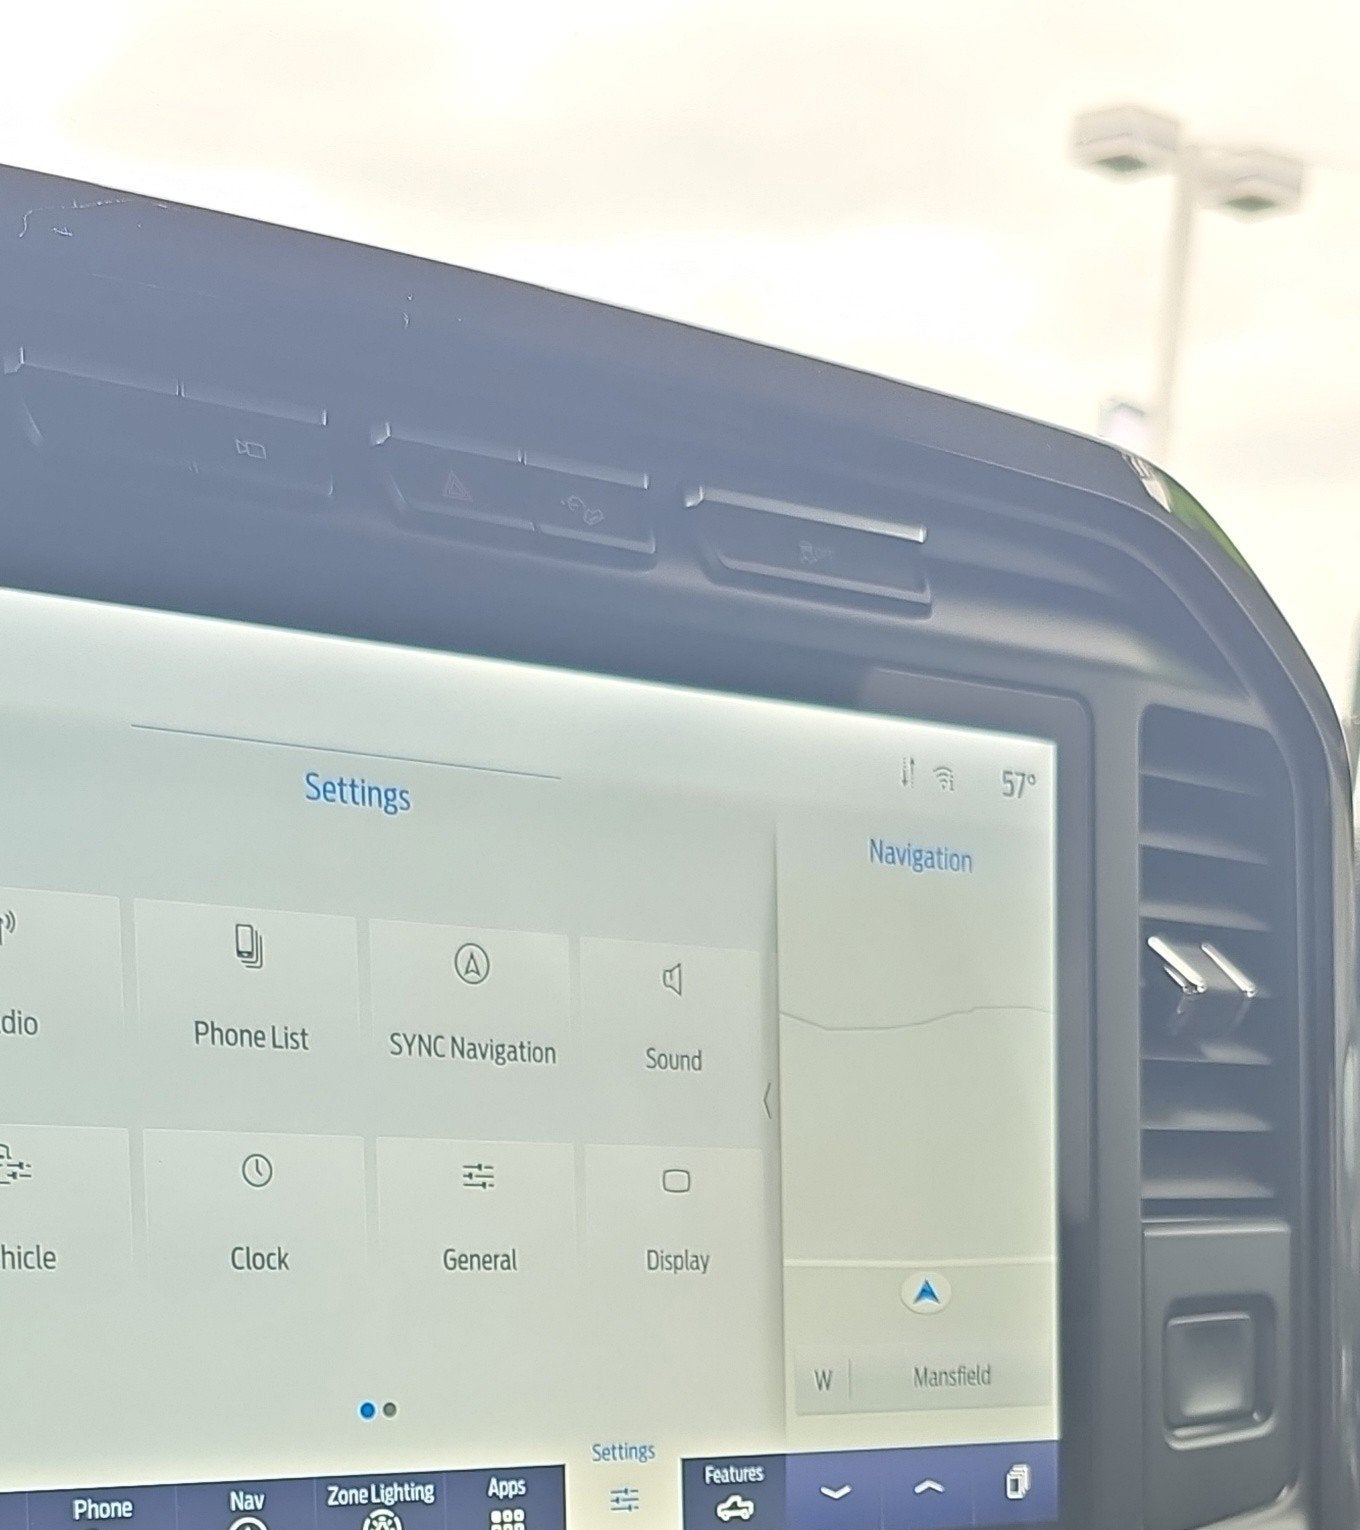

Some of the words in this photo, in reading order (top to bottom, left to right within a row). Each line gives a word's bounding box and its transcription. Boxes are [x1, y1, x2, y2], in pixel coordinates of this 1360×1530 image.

[304, 771, 413, 815] Settings
[869, 837, 974, 874] Navigation
[194, 1019, 266, 1049] Phone
[271, 1023, 310, 1051] List
[389, 1032, 446, 1059] SYNC
[450, 1035, 557, 1067] Navigation
[645, 1047, 703, 1072] Sound
[230, 1245, 290, 1272] Clock
[442, 1247, 518, 1272] General
[645, 1248, 710, 1275] Display
[814, 1369, 834, 1392] W
[913, 1363, 993, 1389] Mansfield
[591, 1441, 657, 1465] Settings
[704, 1465, 765, 1485] Features
[326, 1484, 369, 1506] Zone
[370, 1480, 436, 1506] Lighting
[487, 1477, 527, 1500] Apps
[72, 1497, 134, 1522] Phone
[229, 1491, 266, 1512] Nav
